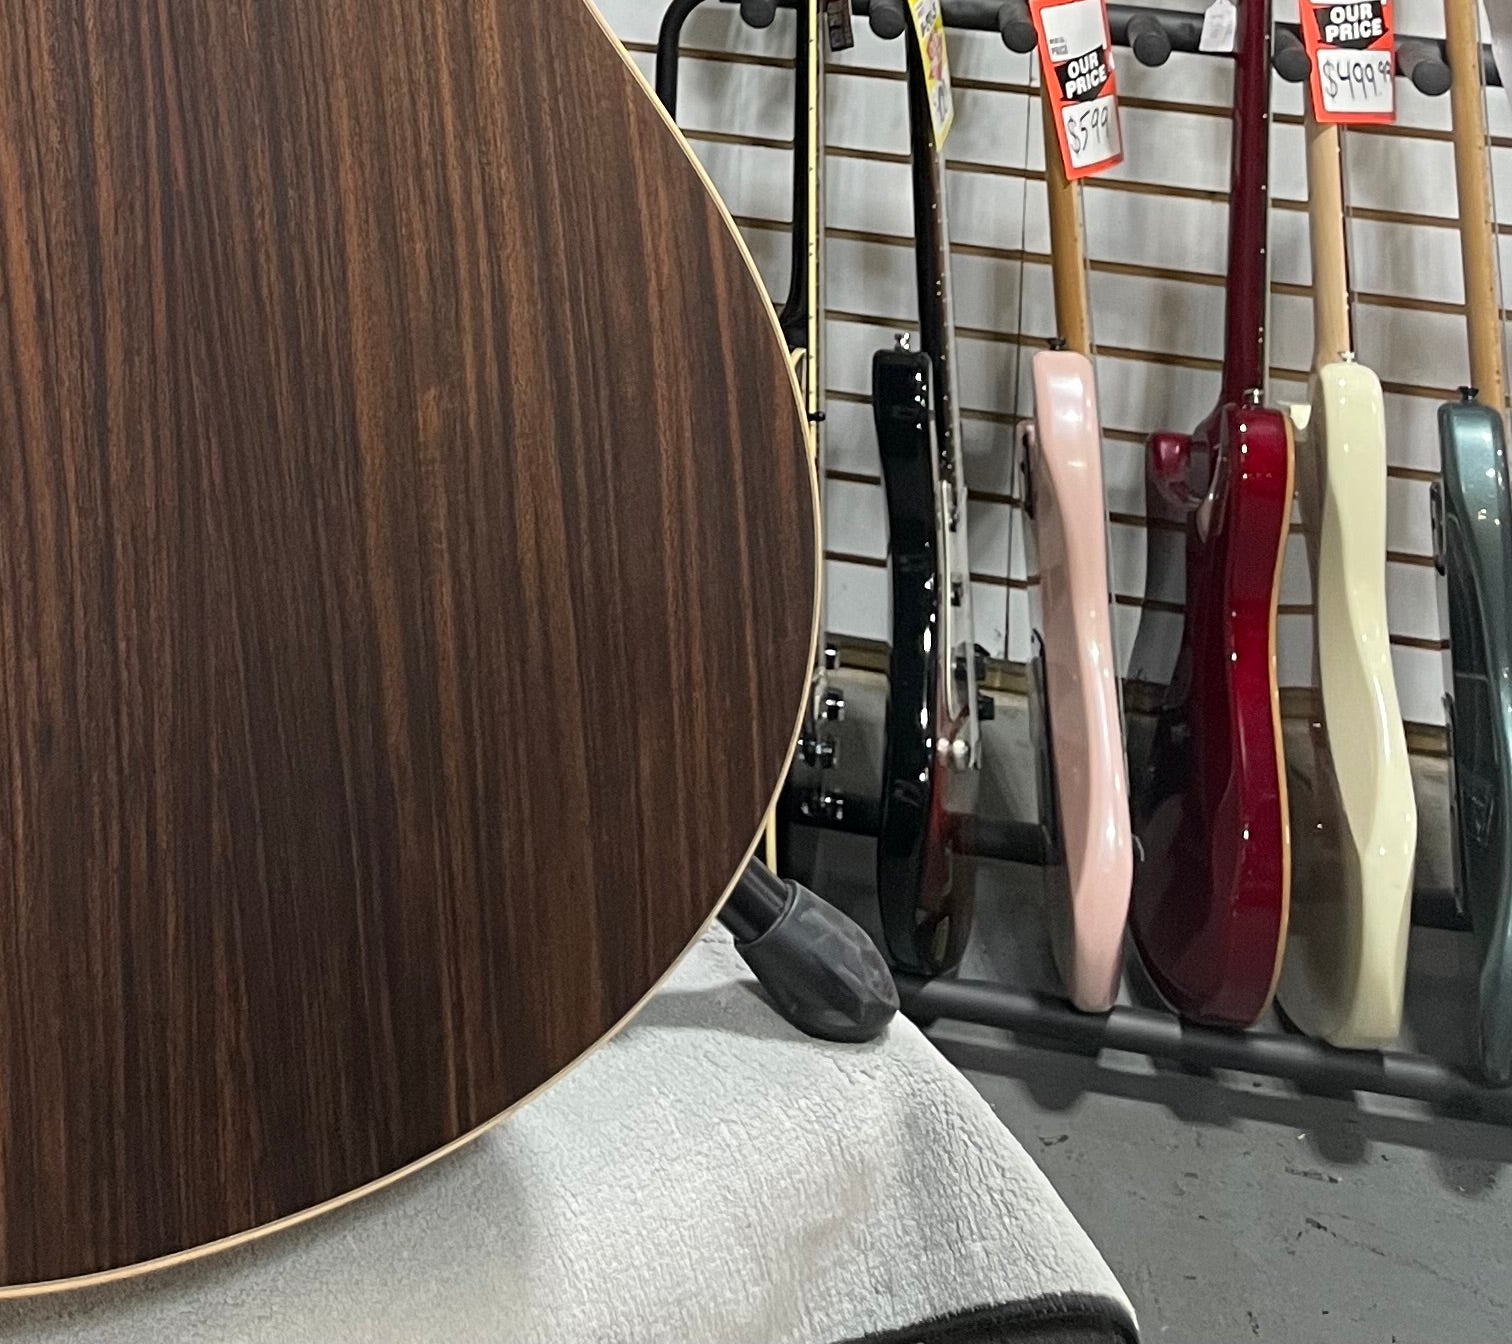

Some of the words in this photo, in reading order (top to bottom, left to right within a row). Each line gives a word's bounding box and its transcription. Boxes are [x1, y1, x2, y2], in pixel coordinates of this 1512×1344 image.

[1329, 2, 1374, 25] OUR
[1324, 17, 1384, 43] PRICE
[1067, 51, 1100, 80] OUR
[1064, 64, 1108, 100] PRICE
[1067, 105, 1110, 155] $599
